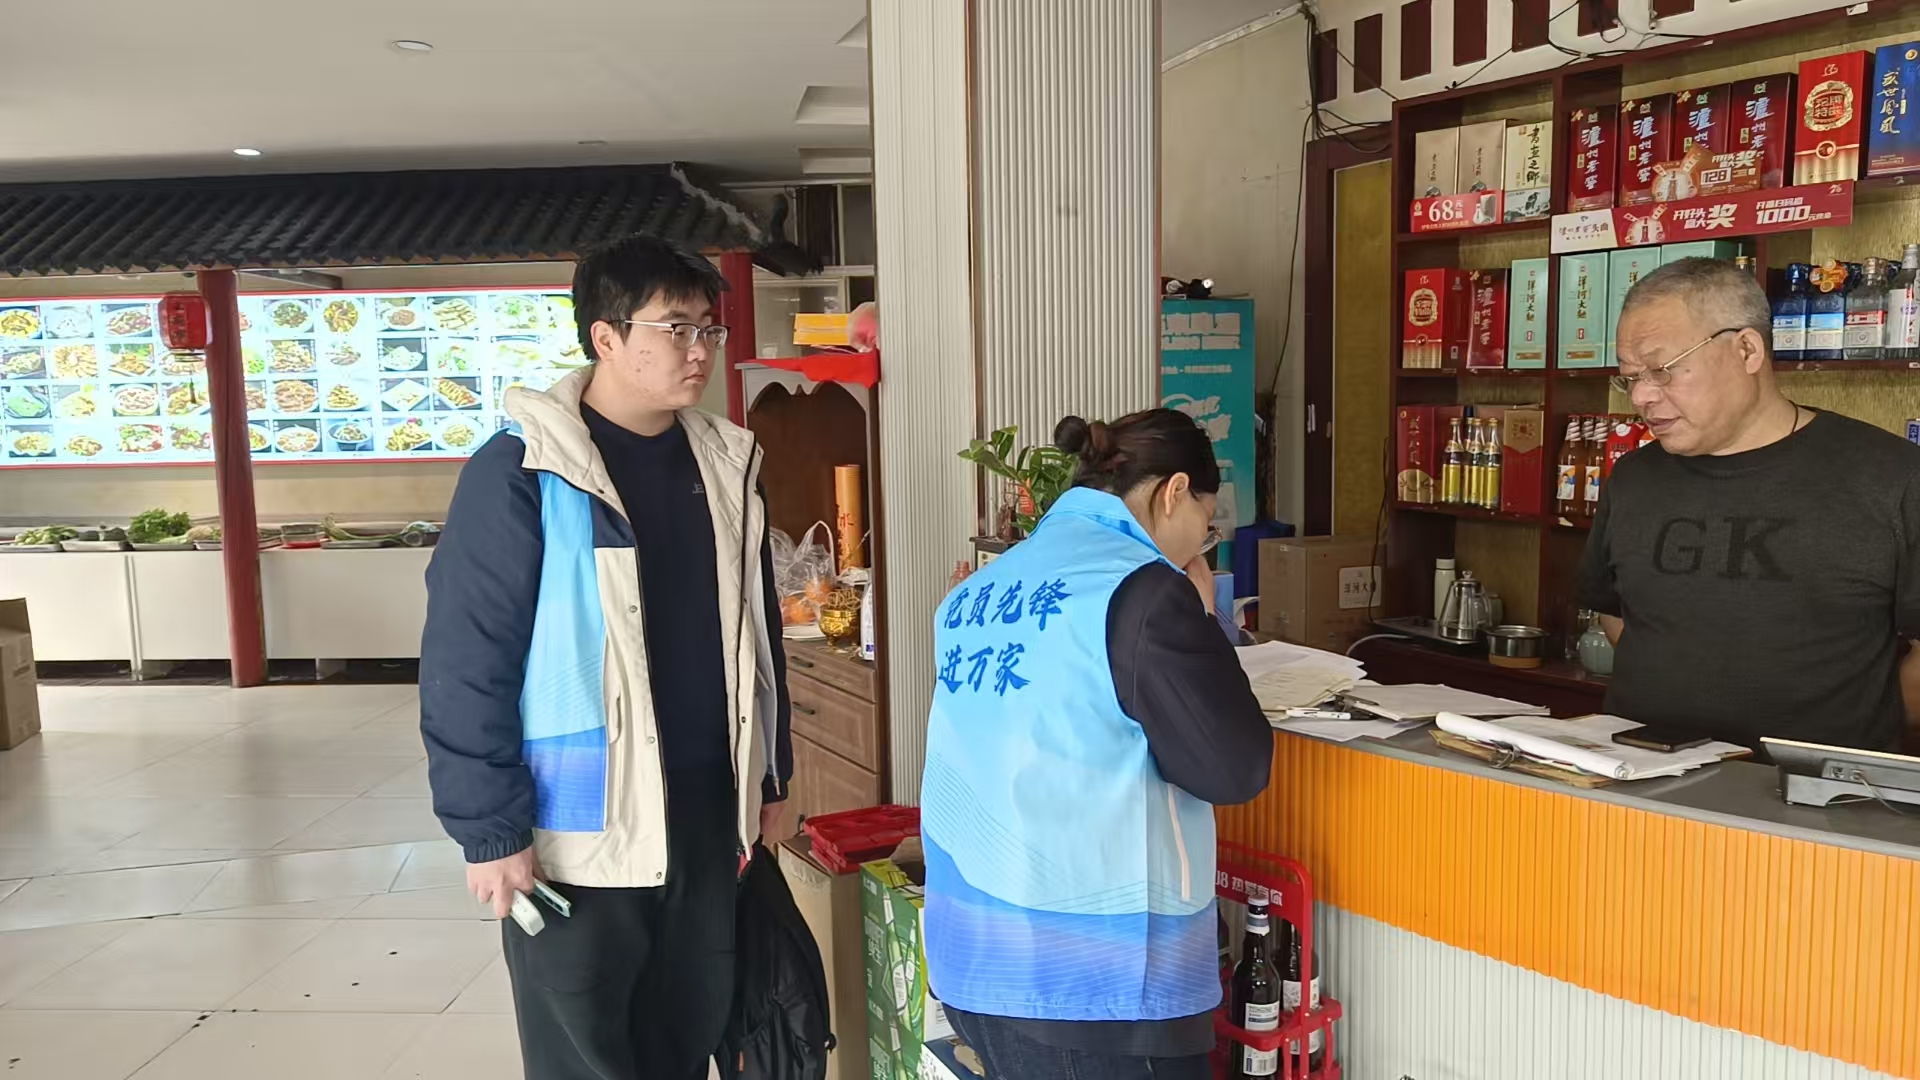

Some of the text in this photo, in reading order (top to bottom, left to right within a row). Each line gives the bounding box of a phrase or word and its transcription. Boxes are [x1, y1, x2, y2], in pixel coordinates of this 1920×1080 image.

[1704, 171, 1727, 183] 128
[1429, 199, 1453, 221] 68
[1653, 516, 1800, 582] GK
[938, 644, 1031, 697] 进万家
